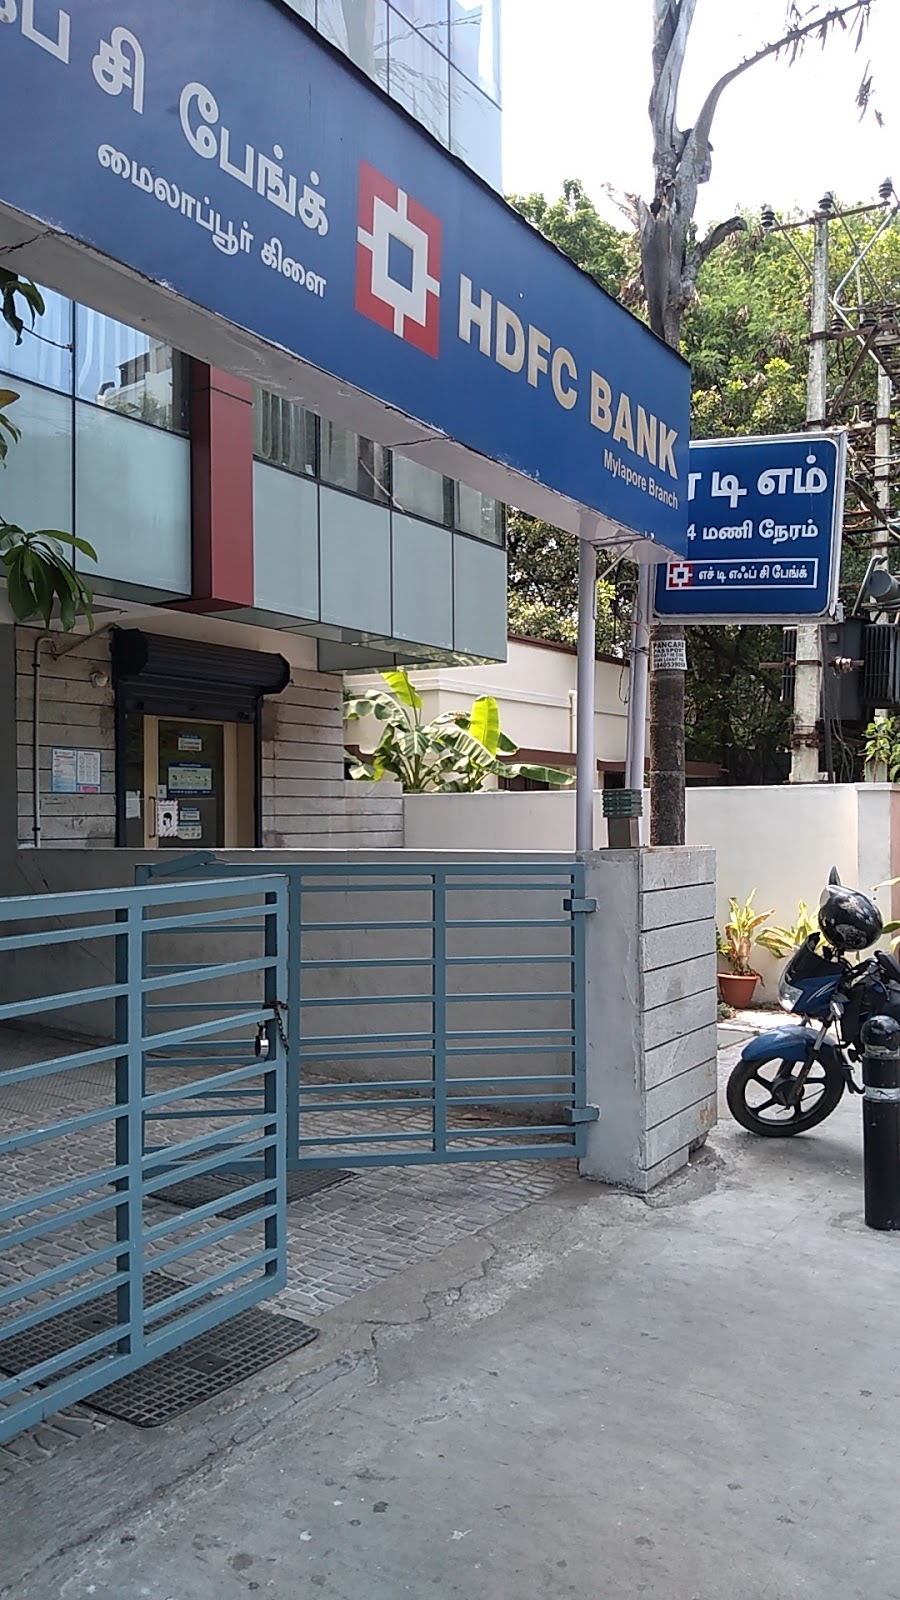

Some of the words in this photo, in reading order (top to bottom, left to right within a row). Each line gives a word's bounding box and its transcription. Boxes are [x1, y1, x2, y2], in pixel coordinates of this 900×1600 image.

[92, 26, 145, 115] சி
[179, 81, 329, 236] பேங்க்
[97, 143, 253, 256] மைலாப்பூர்
[260, 236, 327, 298] கிளை
[458, 273, 578, 410] HDFC
[590, 370, 679, 480] BANK
[603, 449, 647, 491] Mylapore
[648, 476, 679, 510] Branch
[711, 471, 748, 509] டி
[757, 455, 828, 496] எம்
[686, 523, 697, 541] 4
[702, 519, 754, 541] மணி
[758, 518, 819, 545] நேரம்
[698, 566, 715, 580] எச்
[716, 570, 727, 583] டி
[759, 564, 770, 580] சி
[771, 563, 808, 579] பேங்க்
